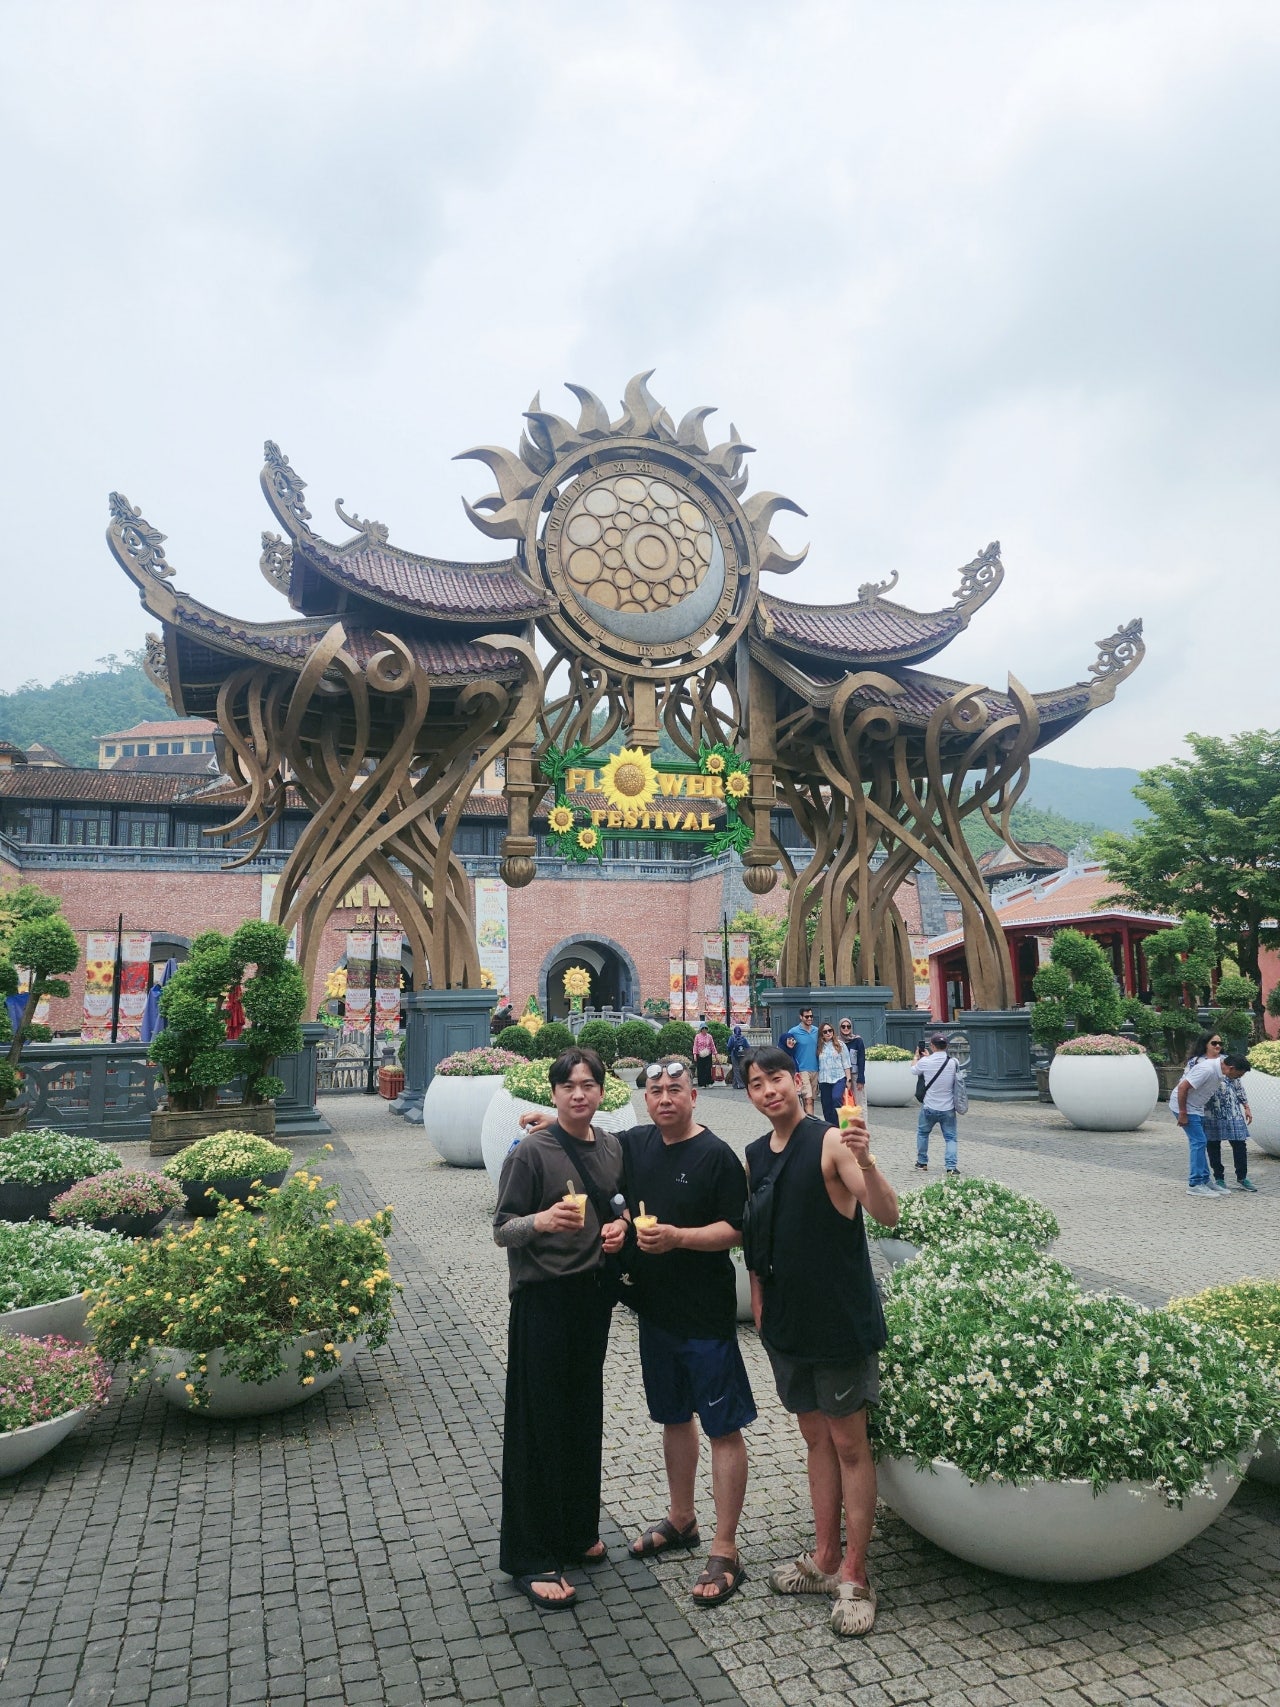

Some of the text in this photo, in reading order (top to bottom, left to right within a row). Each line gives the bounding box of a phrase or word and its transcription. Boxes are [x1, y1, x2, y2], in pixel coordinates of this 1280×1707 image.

[592, 468, 602, 479] X
[613, 463, 626, 473] XI
[636, 463, 653, 474] XII
[572, 480, 585, 493] IX
[591, 809, 716, 831] FESTIVAL
